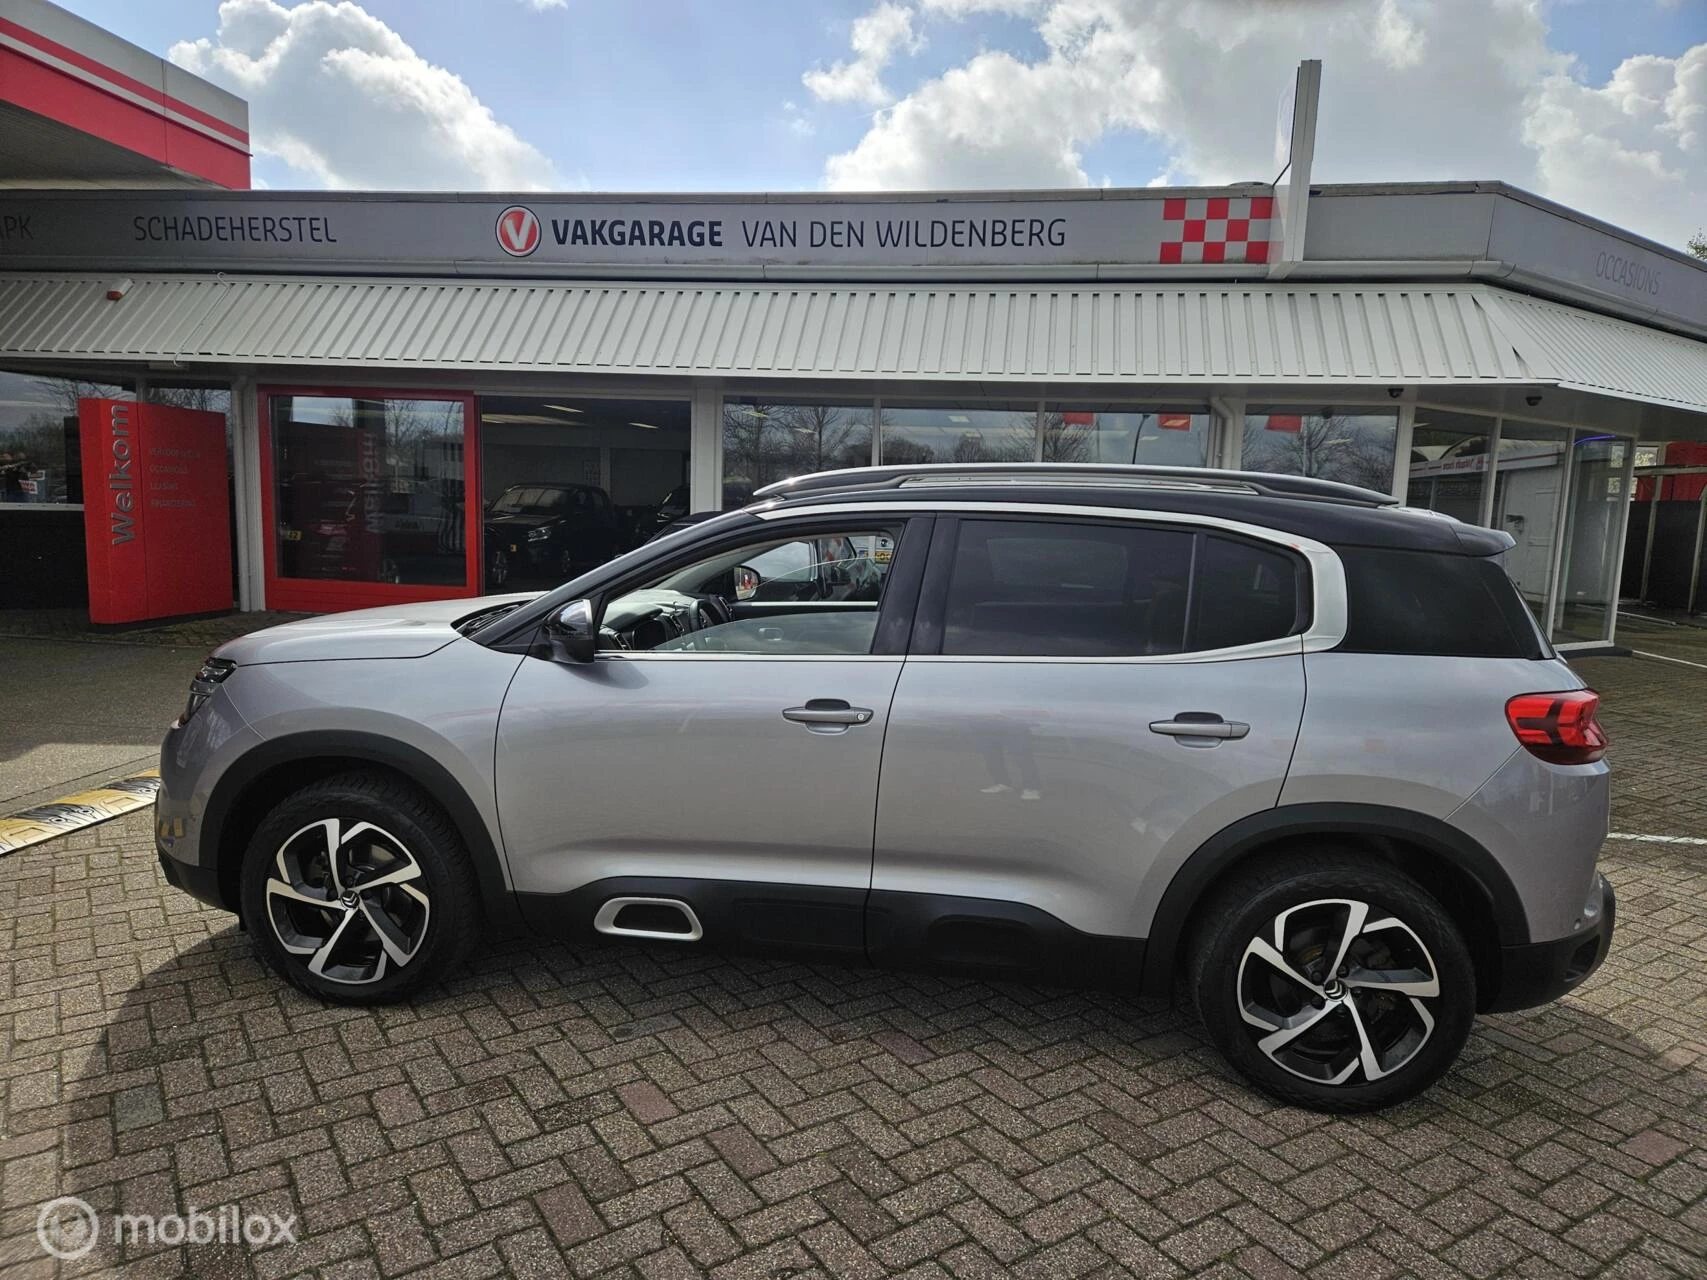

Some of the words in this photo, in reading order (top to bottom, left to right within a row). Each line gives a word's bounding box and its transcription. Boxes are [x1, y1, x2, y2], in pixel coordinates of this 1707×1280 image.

[0, 216, 34, 241] PK
[133, 215, 337, 243] SCHADEHERSTEL
[552, 219, 723, 247] VAKGARAGE
[742, 220, 797, 247] VAN
[810, 220, 864, 247] DEN
[876, 218, 1066, 247] WILDENBERG
[1595, 251, 1662, 296] OCCASIONS
[109, 404, 136, 545] Welkom
